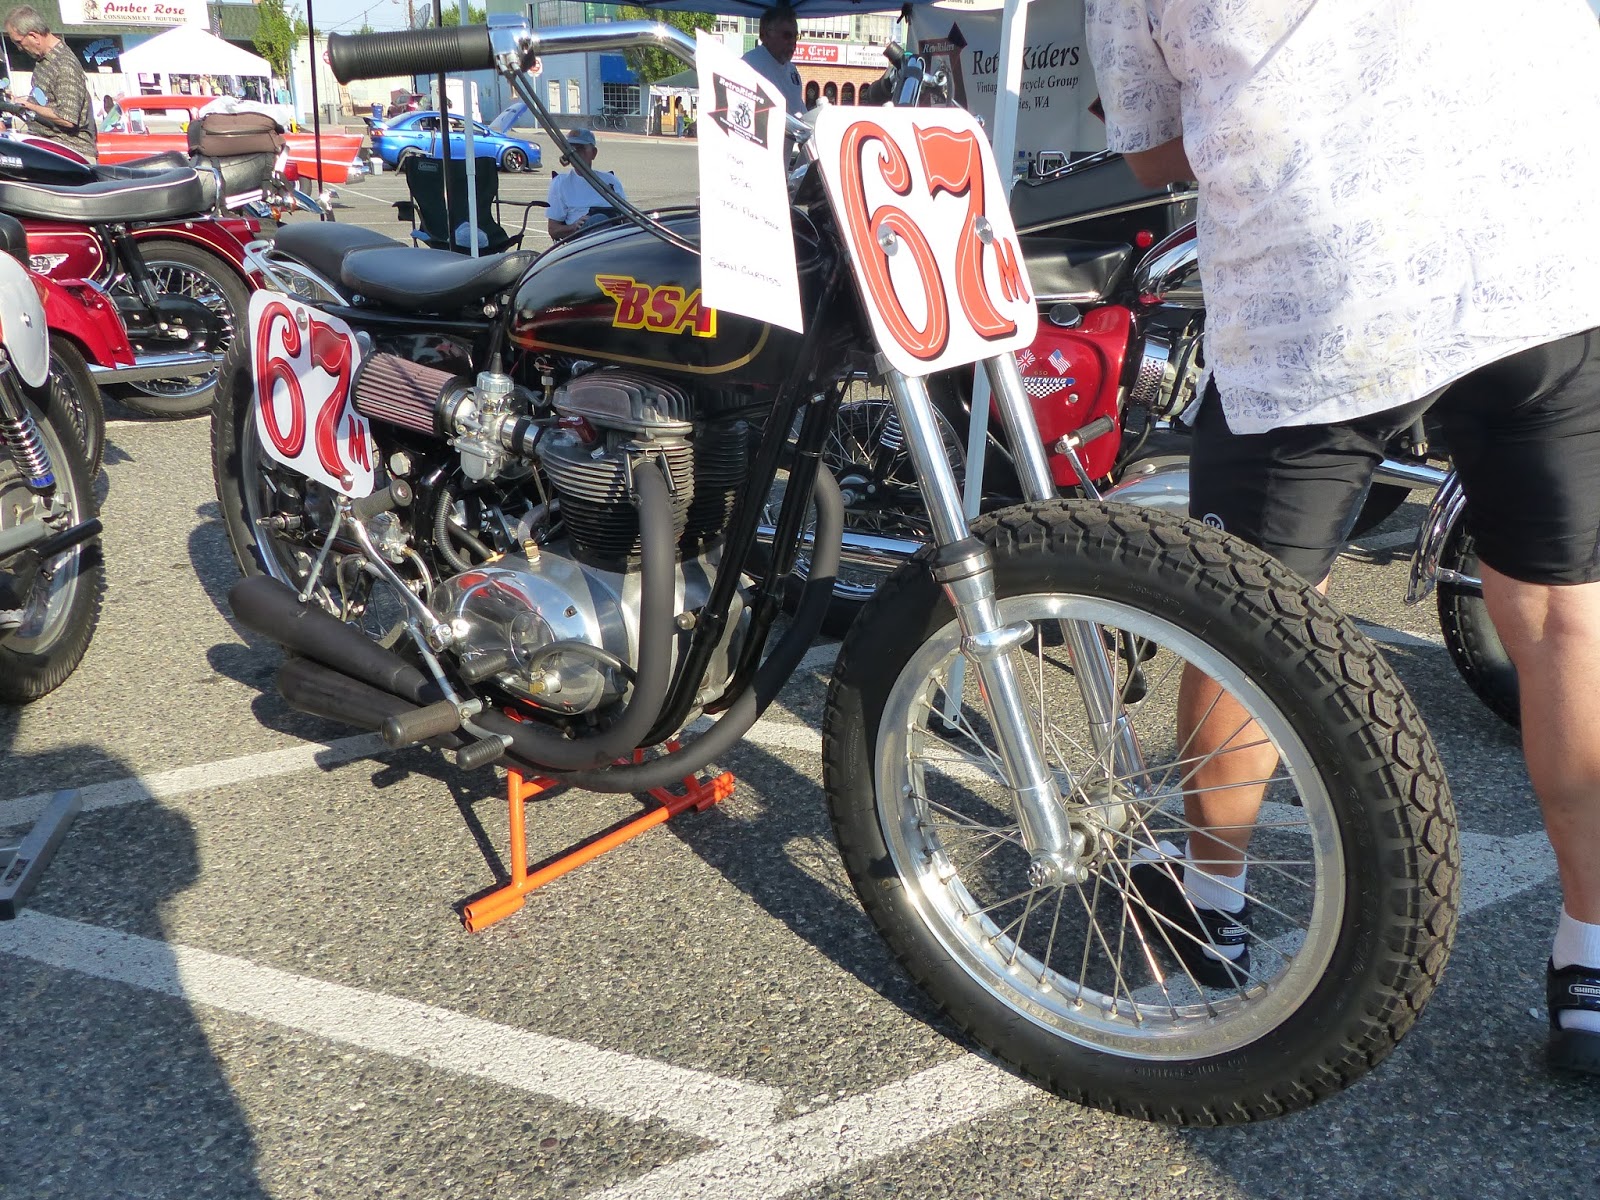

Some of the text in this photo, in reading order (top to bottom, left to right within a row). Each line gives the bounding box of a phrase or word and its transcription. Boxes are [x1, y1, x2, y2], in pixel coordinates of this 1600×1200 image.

[104, 2, 185, 15] Amber Rose
[808, 45, 836, 57] Crier
[719, 77, 765, 104] RetroRiders
[976, 82, 998, 96] Vintag
[1047, 75, 1079, 91] Group
[1034, 96, 1050, 109] WA
[614, 284, 715, 335] BSA
[1022, 376, 1067, 384] GHTNING
[1573, 986, 1600, 995] SHIMA
